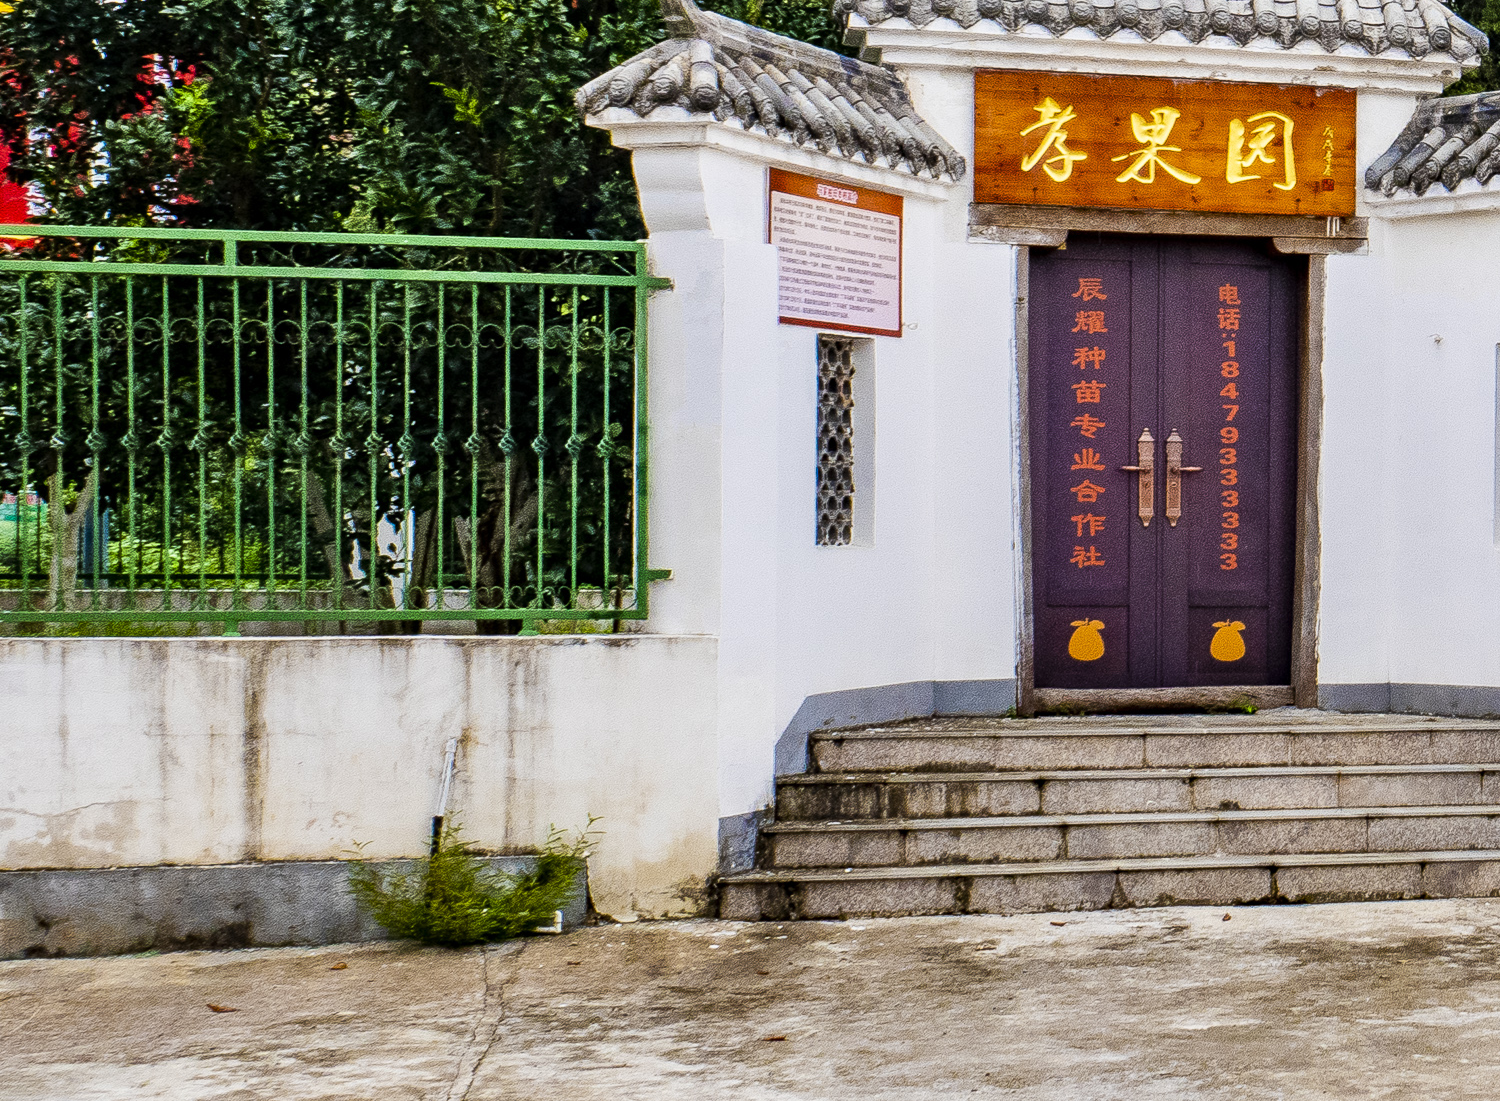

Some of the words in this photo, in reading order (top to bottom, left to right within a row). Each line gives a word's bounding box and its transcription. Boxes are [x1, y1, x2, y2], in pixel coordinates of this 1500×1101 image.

[1019, 95, 1297, 191] 孝果园
[1069, 277, 1108, 569] 辰耀种苗专业合作社
